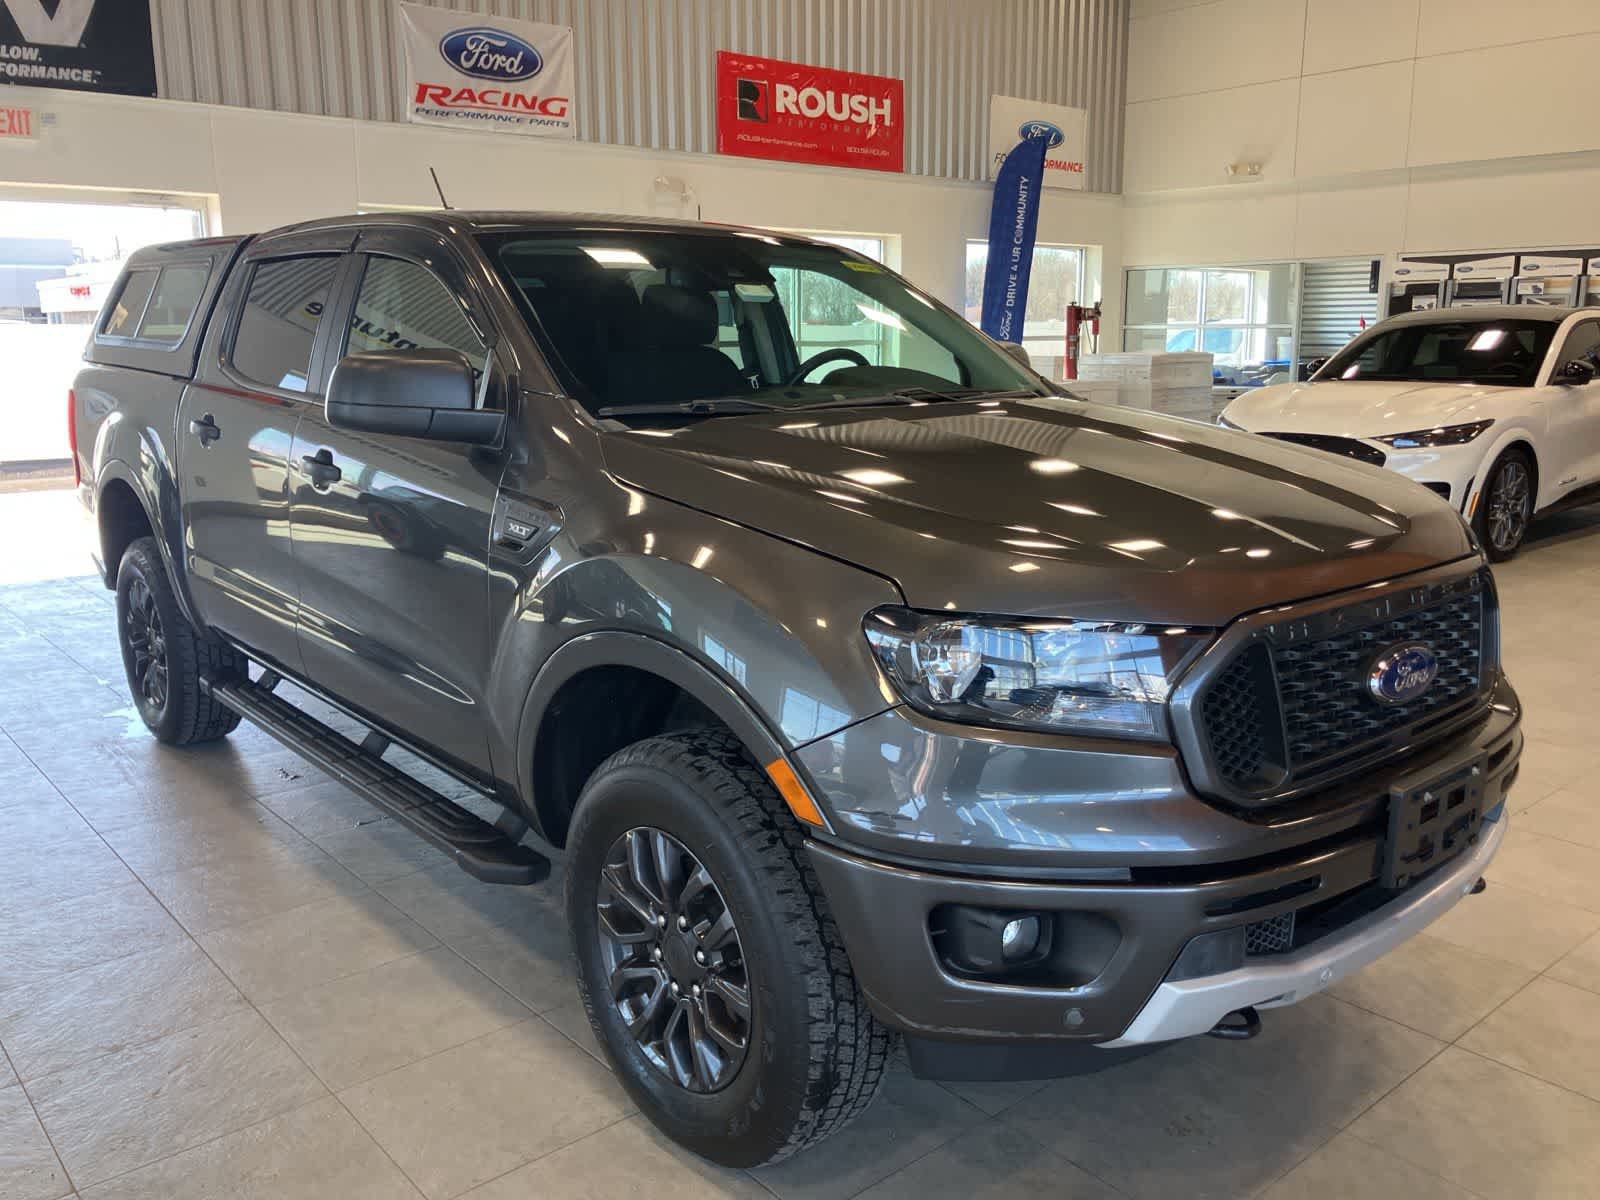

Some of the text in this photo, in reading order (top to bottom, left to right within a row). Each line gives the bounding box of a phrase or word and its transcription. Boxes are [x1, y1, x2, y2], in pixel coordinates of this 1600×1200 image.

[459, 34, 525, 75] Ford
[415, 82, 569, 118] RACING
[774, 82, 893, 127] ROUSH
[0, 108, 31, 137] EXIT
[415, 107, 570, 128] PERFORMANCE PARTS
[1011, 246, 1021, 263] UR
[1005, 273, 1017, 307] DRIVE
[999, 310, 1012, 340] Ford
[508, 522, 530, 536] XLT
